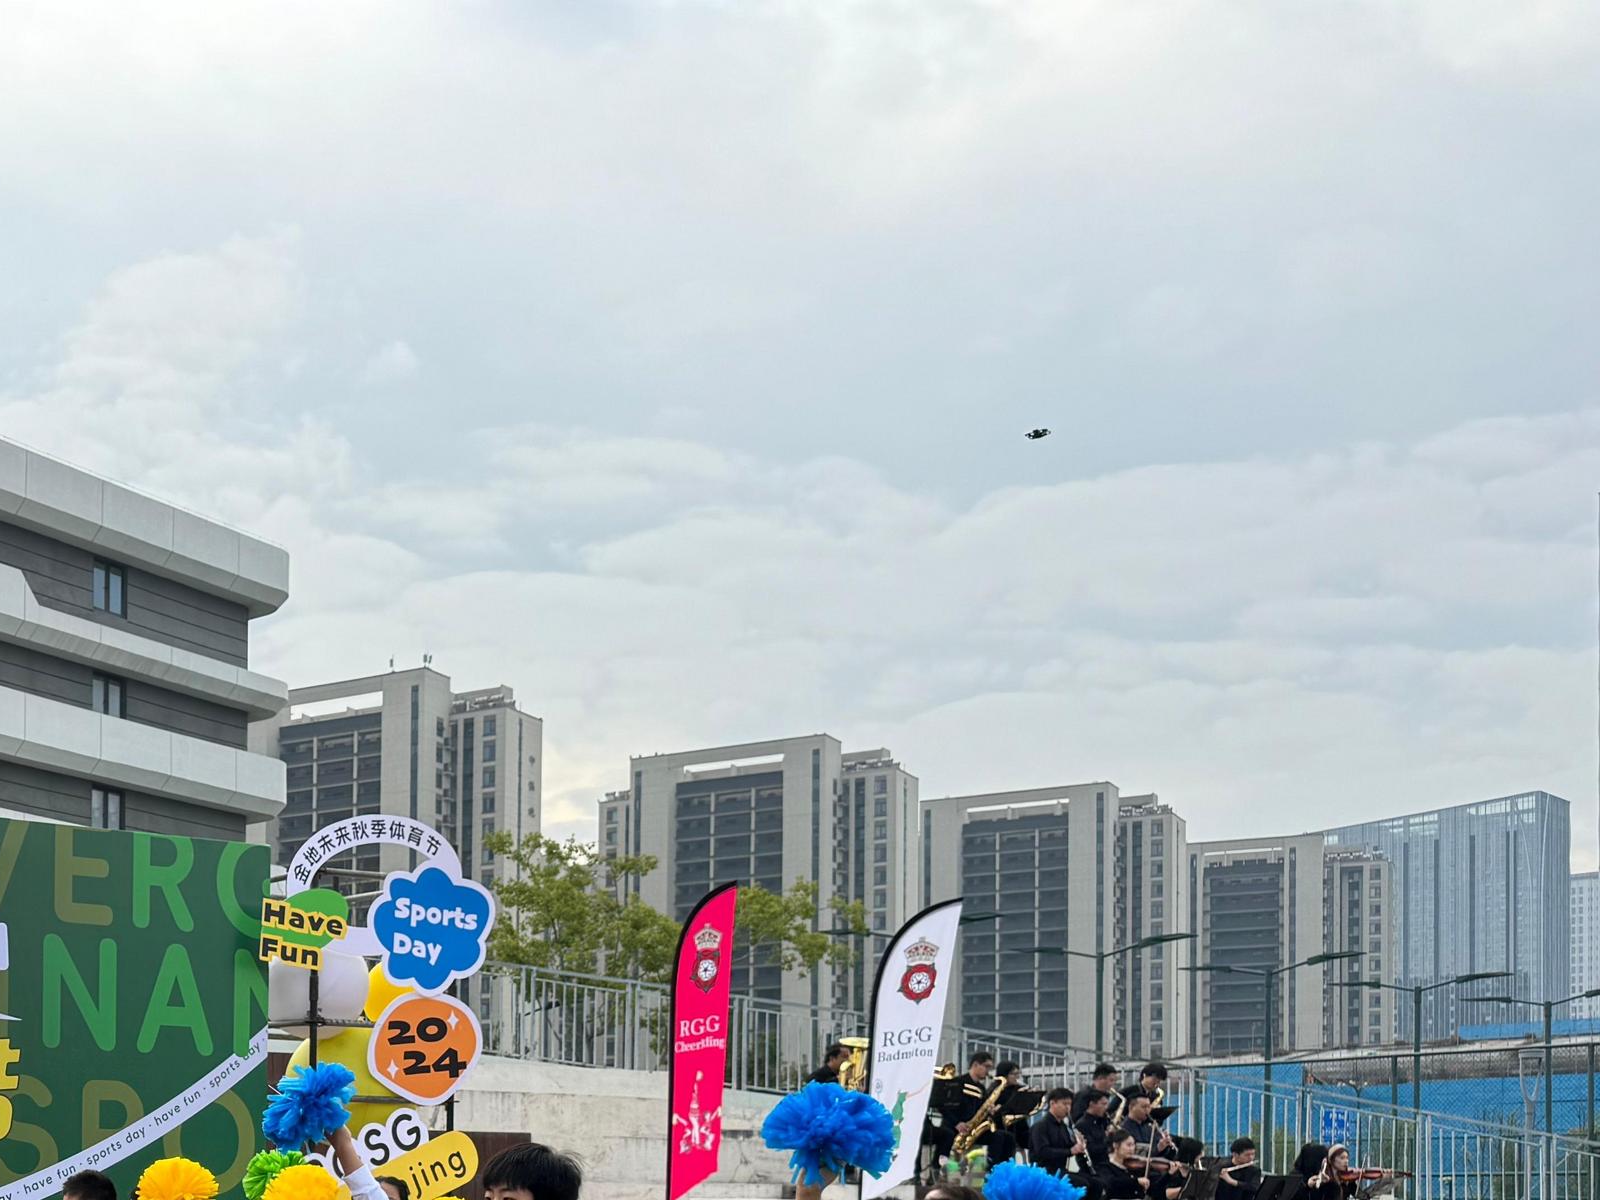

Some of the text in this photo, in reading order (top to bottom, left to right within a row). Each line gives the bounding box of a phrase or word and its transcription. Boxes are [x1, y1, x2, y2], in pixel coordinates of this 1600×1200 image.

[294, 820, 442, 885] 金地未来秋季体育节
[263, 902, 344, 937] Have
[394, 897, 478, 931] Sports
[261, 937, 319, 967] Fun
[393, 932, 443, 966] Day
[387, 1016, 448, 1046] 20
[401, 1049, 468, 1079] 24
[23, 1176, 53, 1195] have
[56, 1164, 77, 1179] fun
[87, 1140, 122, 1165] sports
[125, 1126, 146, 1144] day
[153, 1104, 181, 1127] have
[183, 1091, 201, 1107] fun
[208, 1059, 241, 1088] sports
